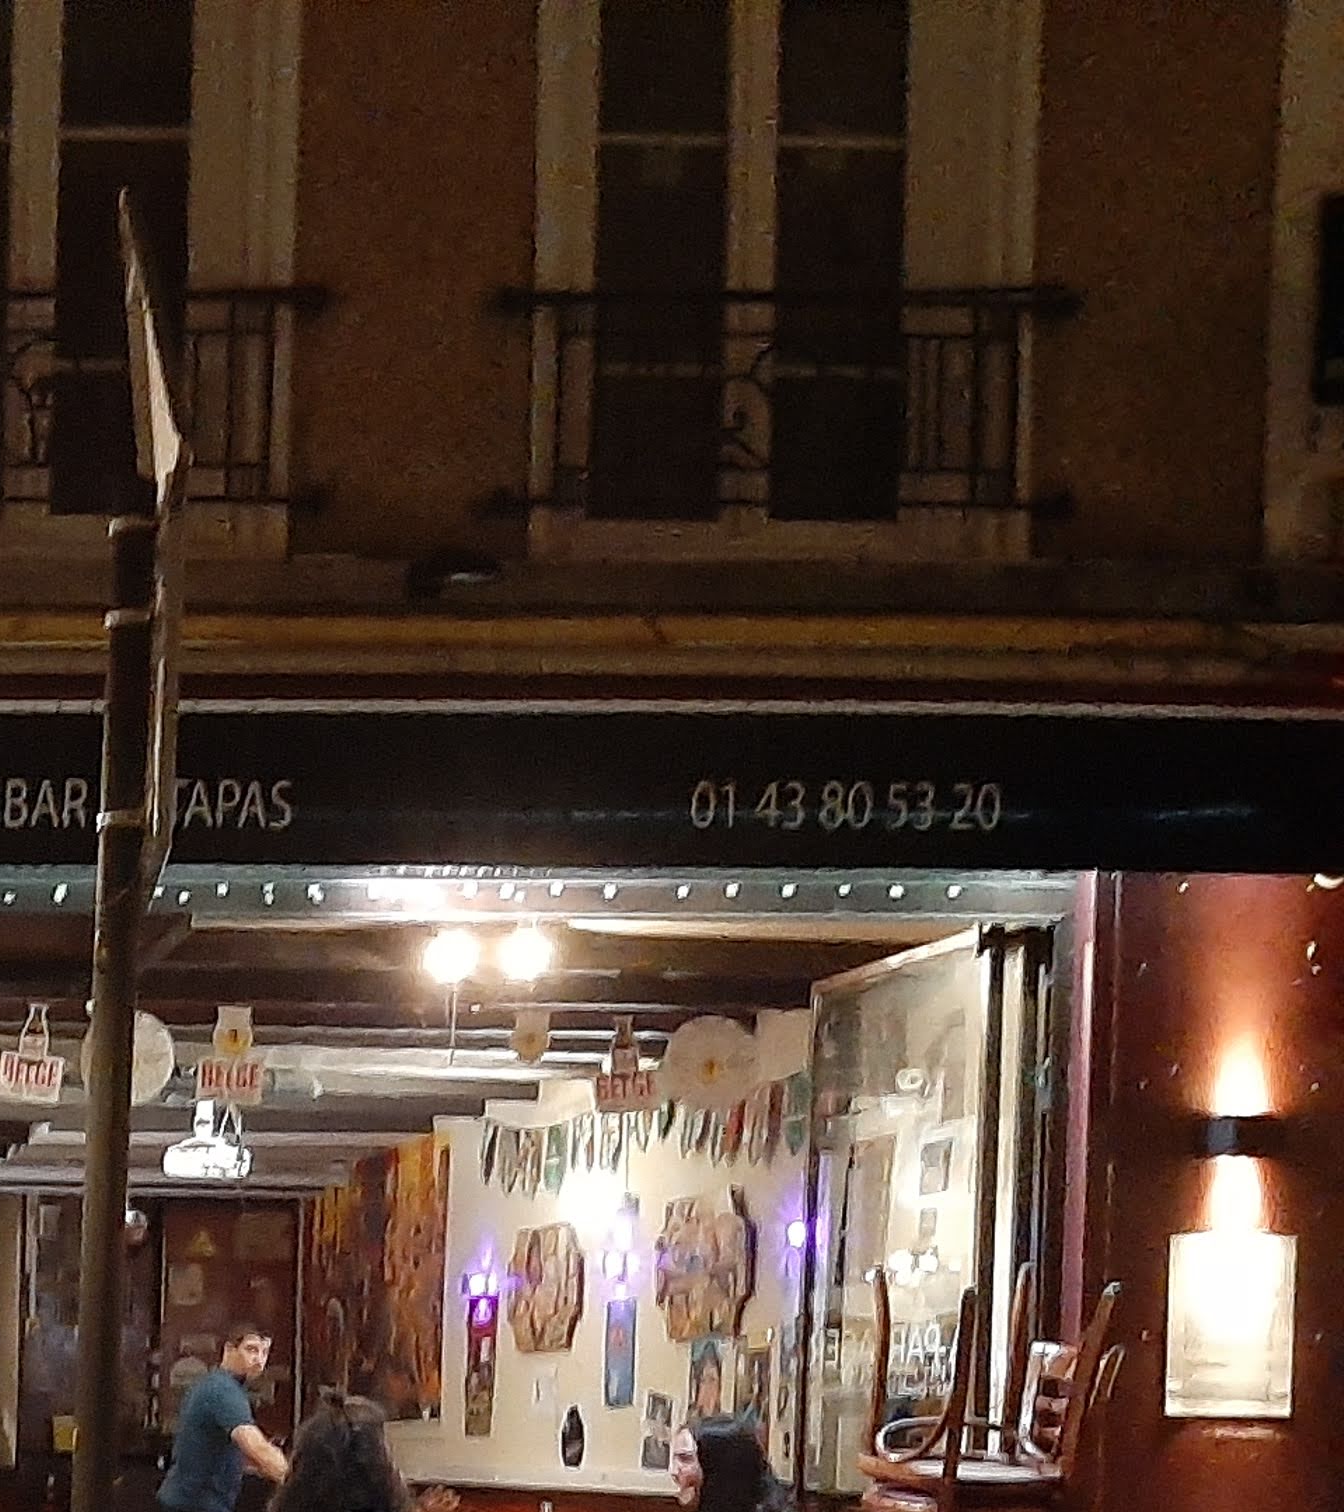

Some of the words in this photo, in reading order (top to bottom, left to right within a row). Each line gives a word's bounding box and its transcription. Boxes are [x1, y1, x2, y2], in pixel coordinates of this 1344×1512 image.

[2, 777, 88, 830] BAR
[690, 779, 736, 830] 01
[755, 780, 806, 832] 43
[818, 779, 873, 831] 80
[886, 780, 936, 832] 53
[949, 782, 1002, 832] 20
